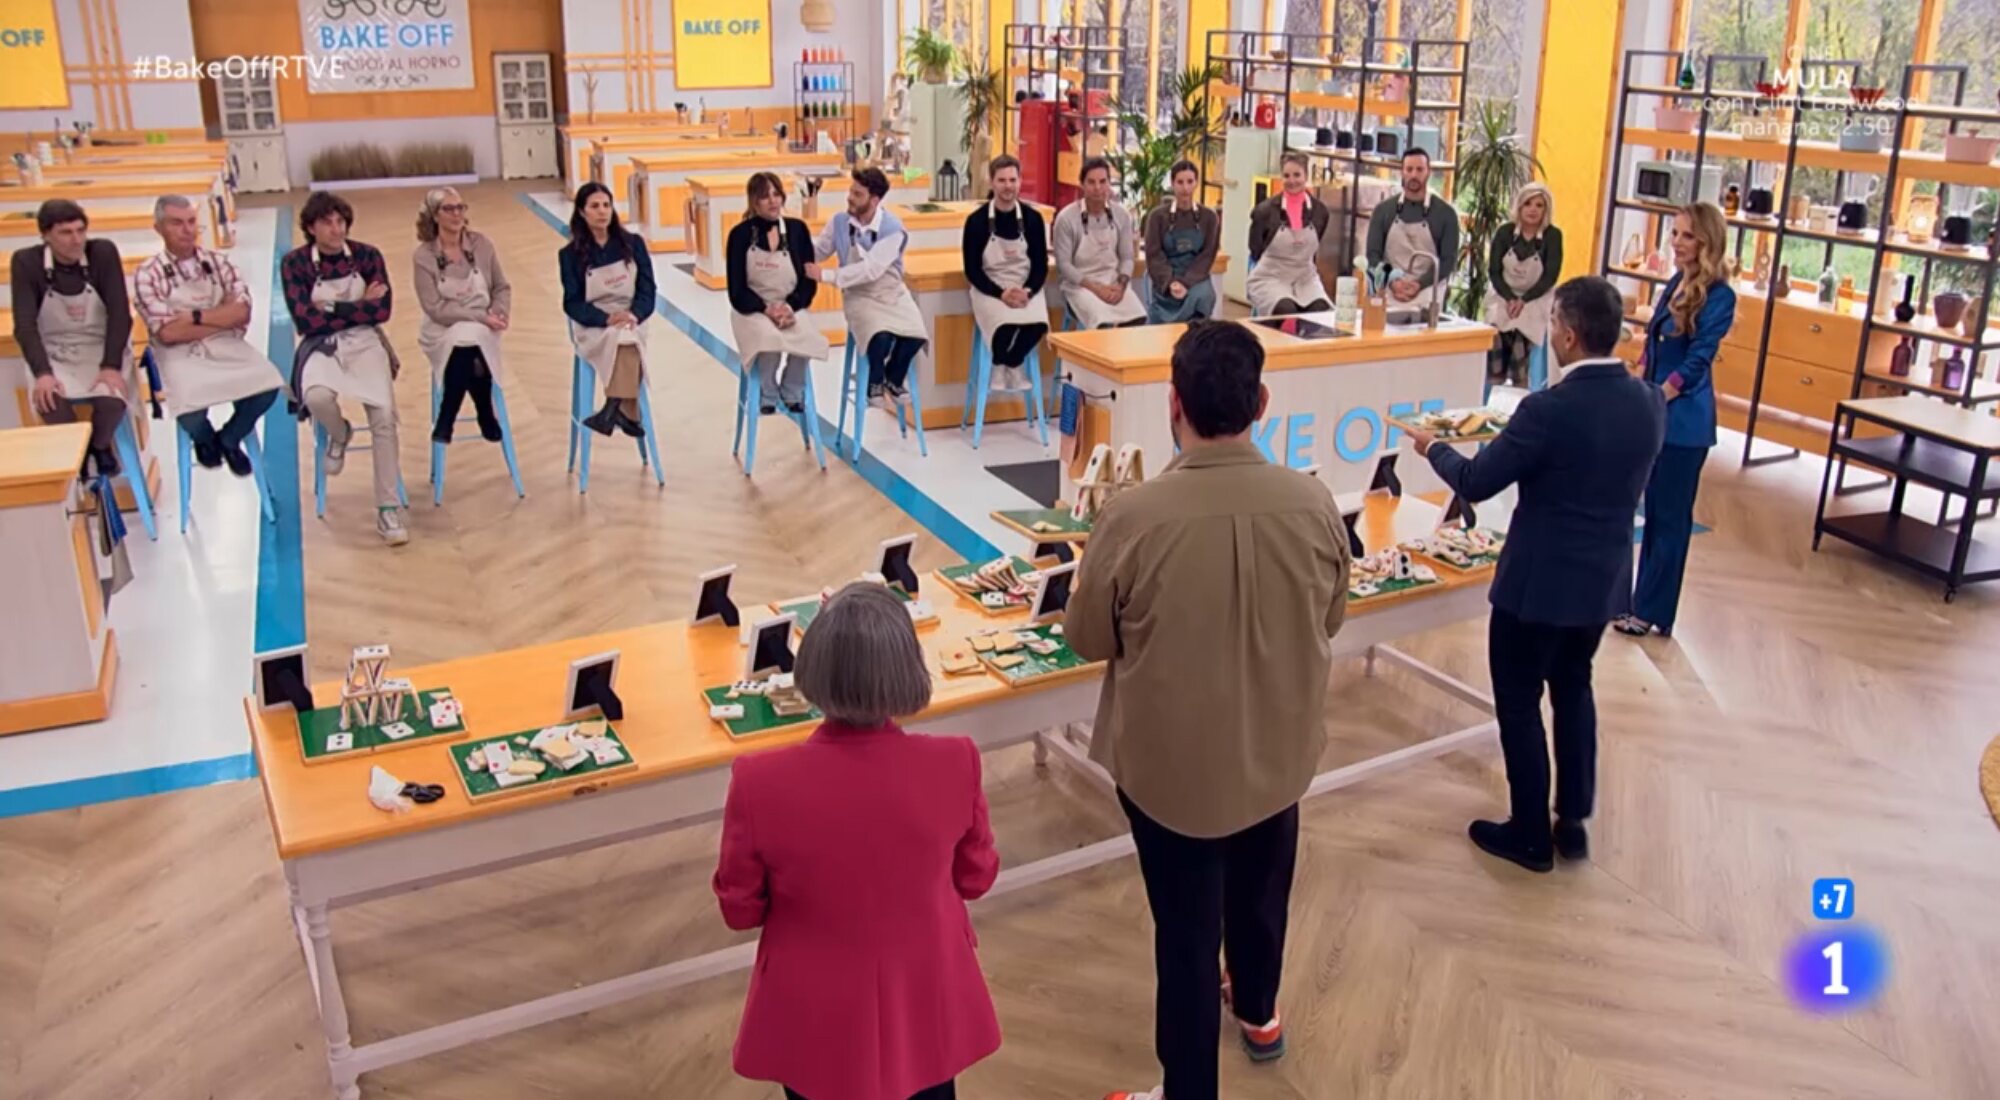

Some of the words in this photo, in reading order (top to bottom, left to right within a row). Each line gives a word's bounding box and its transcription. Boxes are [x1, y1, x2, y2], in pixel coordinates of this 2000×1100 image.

[684, 20, 723, 35] BAKE
[728, 19, 761, 35] OFF
[1, 29, 45, 48] OFF
[320, 24, 389, 49] BAKE
[398, 23, 453, 48] OFF
[388, 58, 404, 70] AL
[408, 55, 461, 70] HORNO
